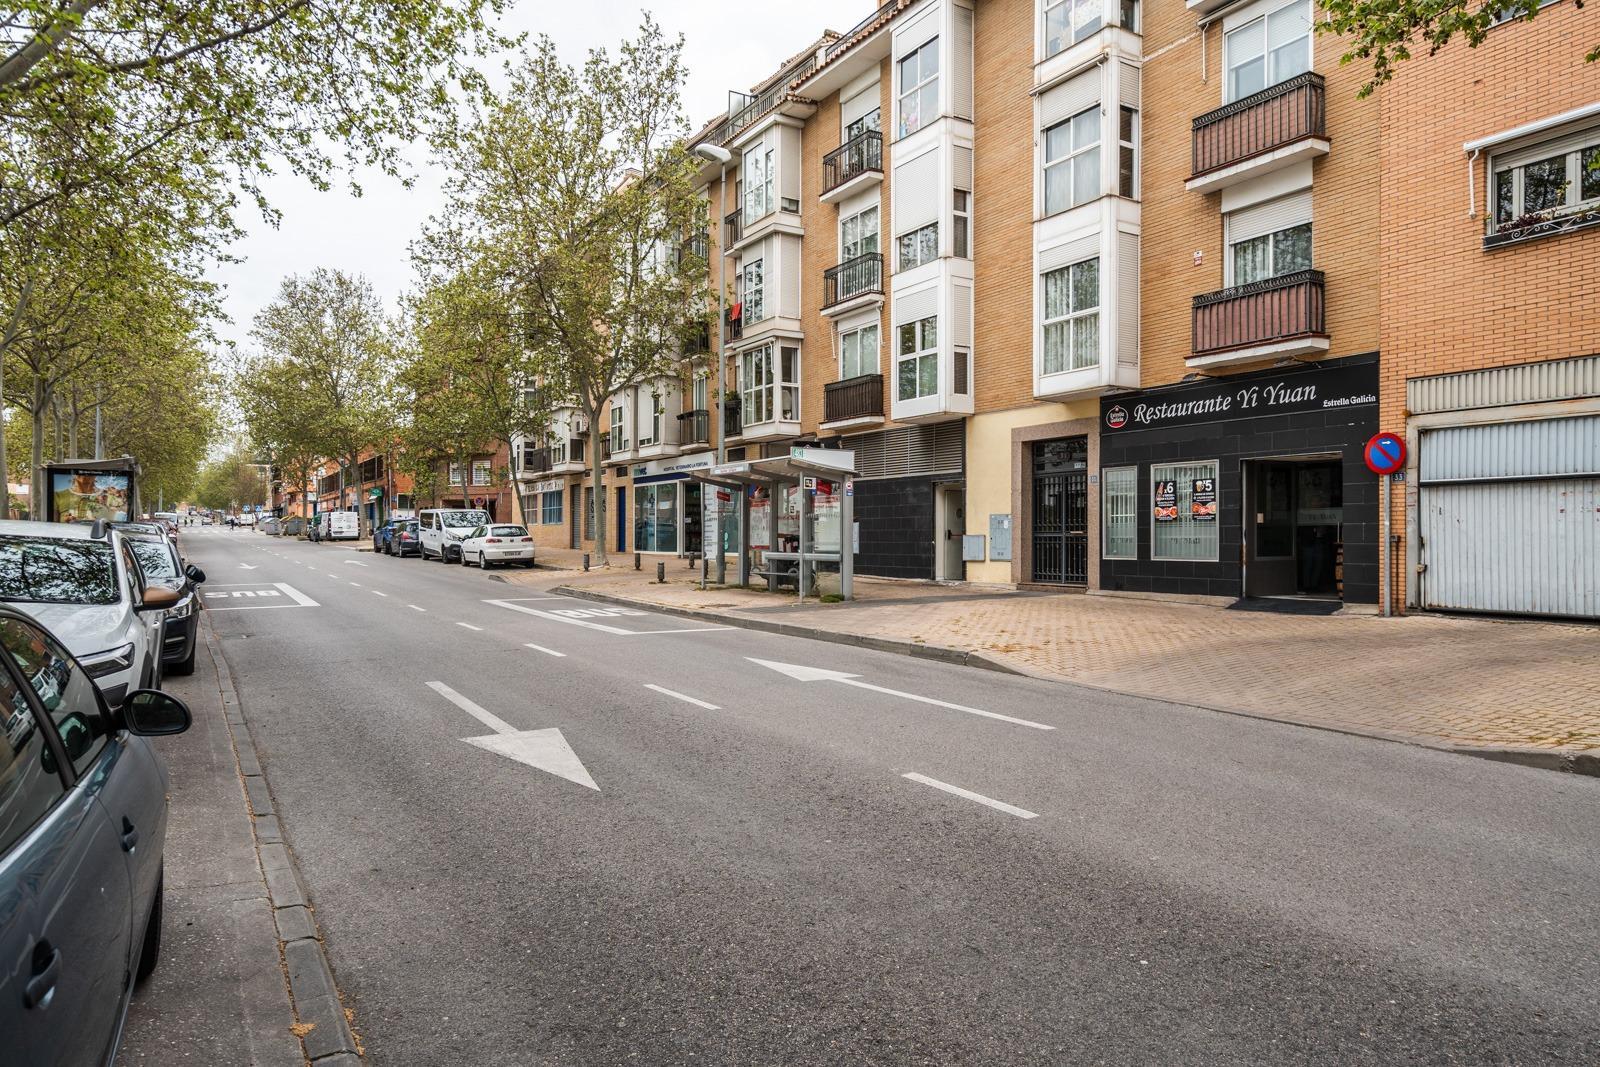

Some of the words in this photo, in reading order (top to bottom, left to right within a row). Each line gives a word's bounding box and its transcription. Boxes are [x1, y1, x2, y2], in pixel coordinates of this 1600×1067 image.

[1133, 394, 1232, 424] Restaurante
[1236, 386, 1259, 409] Yi
[1263, 382, 1317, 406] Yuan
[1322, 398, 1350, 407] Estrella
[1350, 394, 1376, 405] Galicia
[548, 608, 649, 618] BUS
